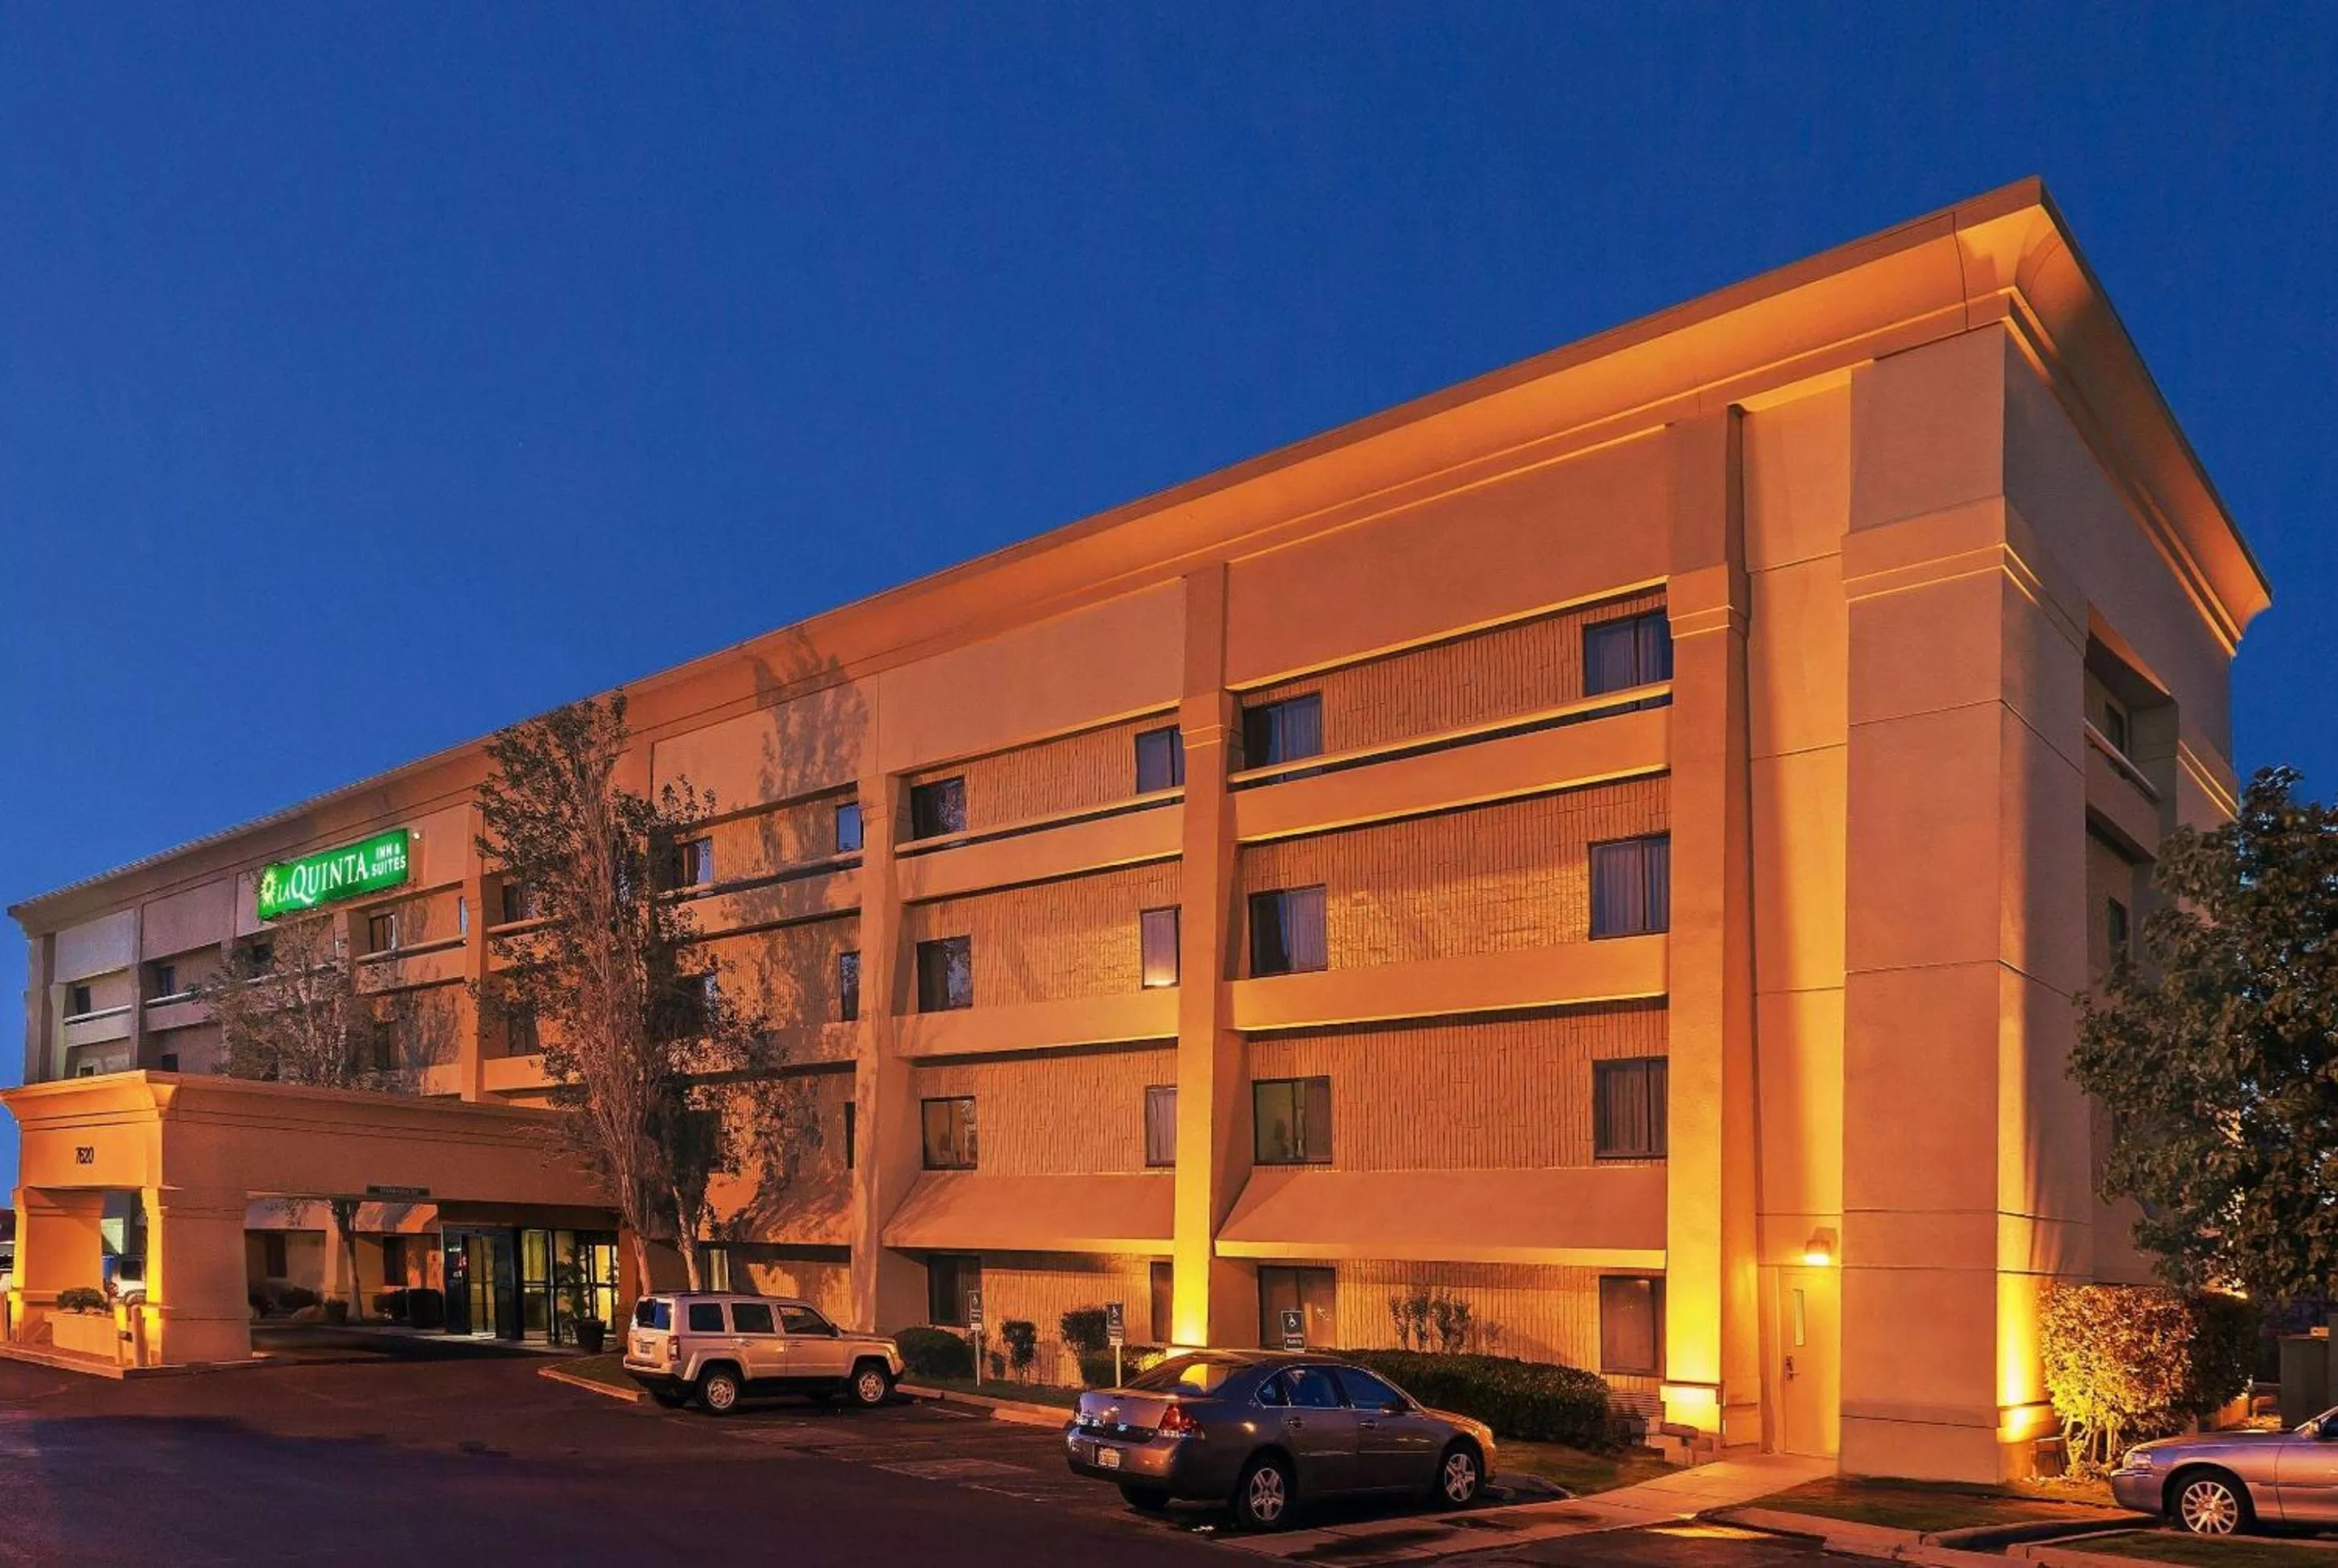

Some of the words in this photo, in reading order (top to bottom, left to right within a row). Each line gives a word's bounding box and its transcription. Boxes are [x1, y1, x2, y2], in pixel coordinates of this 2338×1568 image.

[376, 843, 392, 860] INN
[372, 855, 406, 877] SUITES
[277, 883, 291, 902] LA
[291, 851, 369, 904] QUINTA
[75, 1146, 94, 1164] 7620
